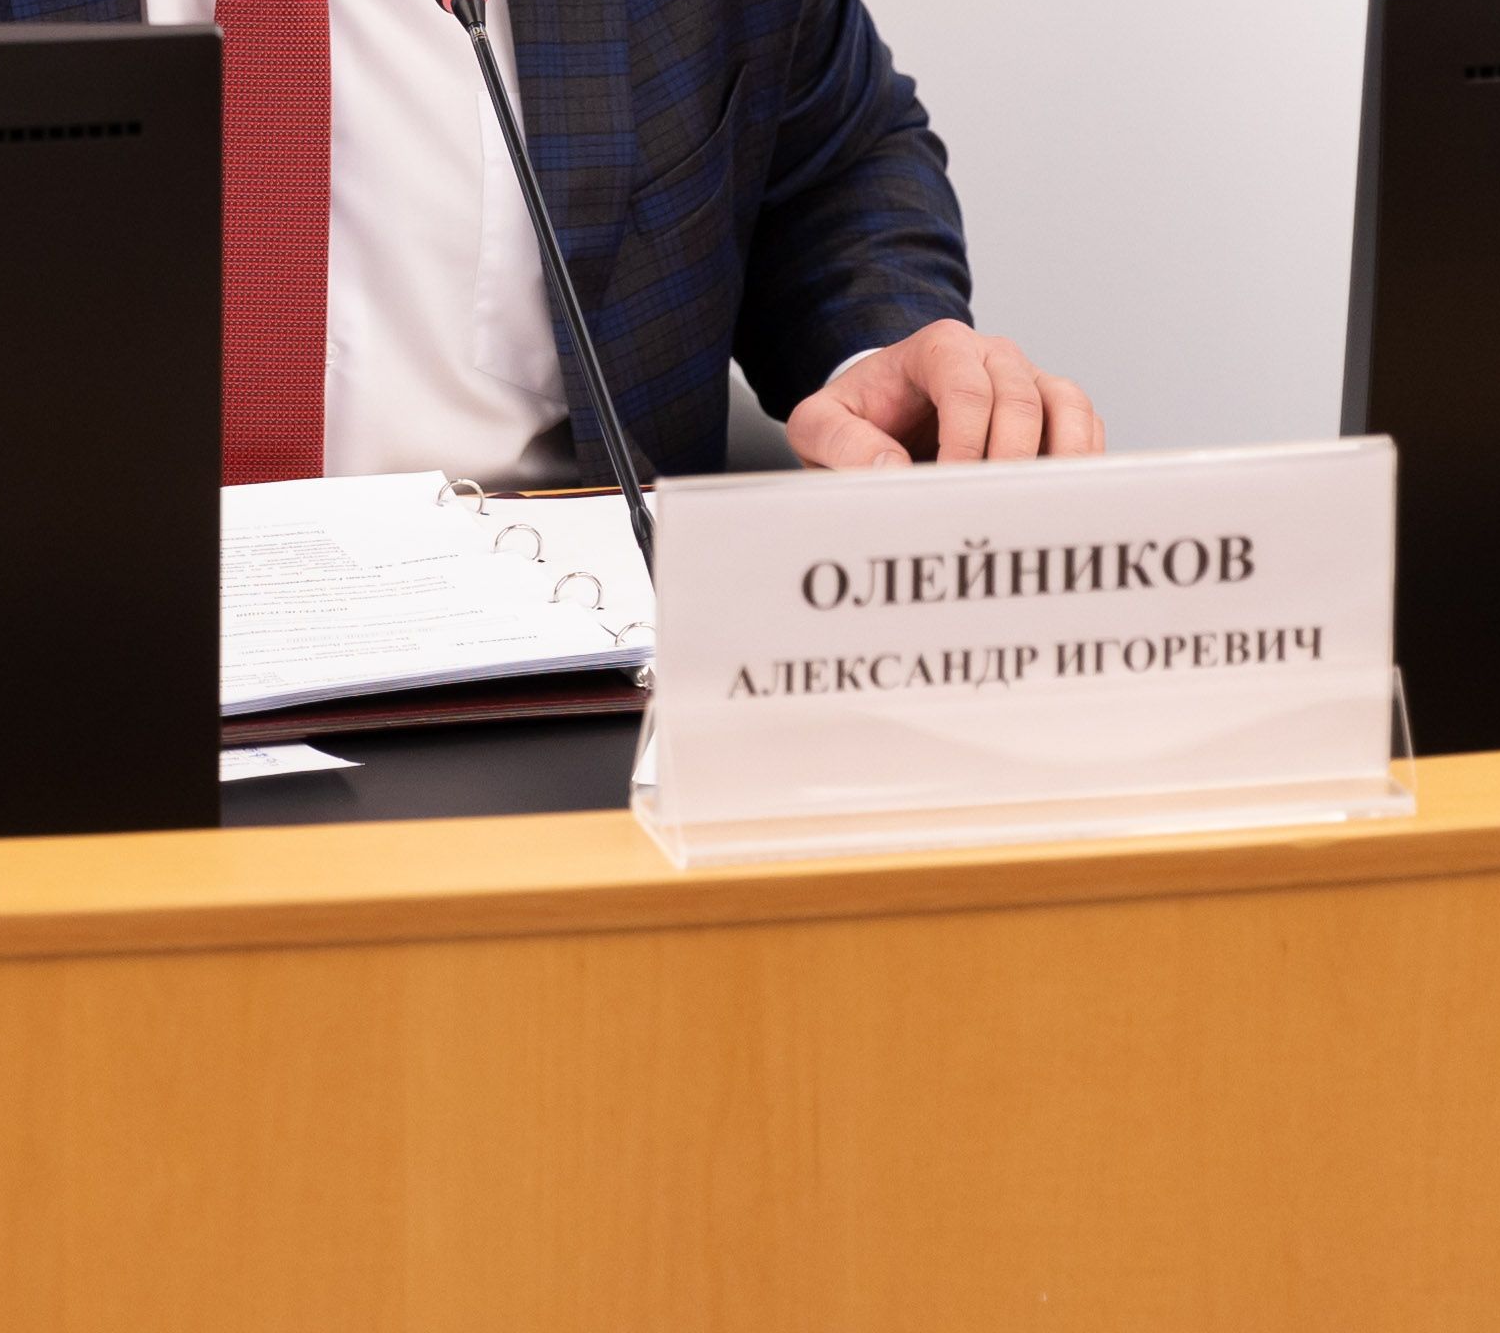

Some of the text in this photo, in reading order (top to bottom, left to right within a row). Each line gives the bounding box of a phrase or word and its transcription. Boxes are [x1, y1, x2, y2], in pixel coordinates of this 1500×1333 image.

[799, 534, 1257, 612] ОЛЕЙНИКОВ
[728, 626, 1324, 699] АЛЕКСАНДР ИГОРЕВИЧ
